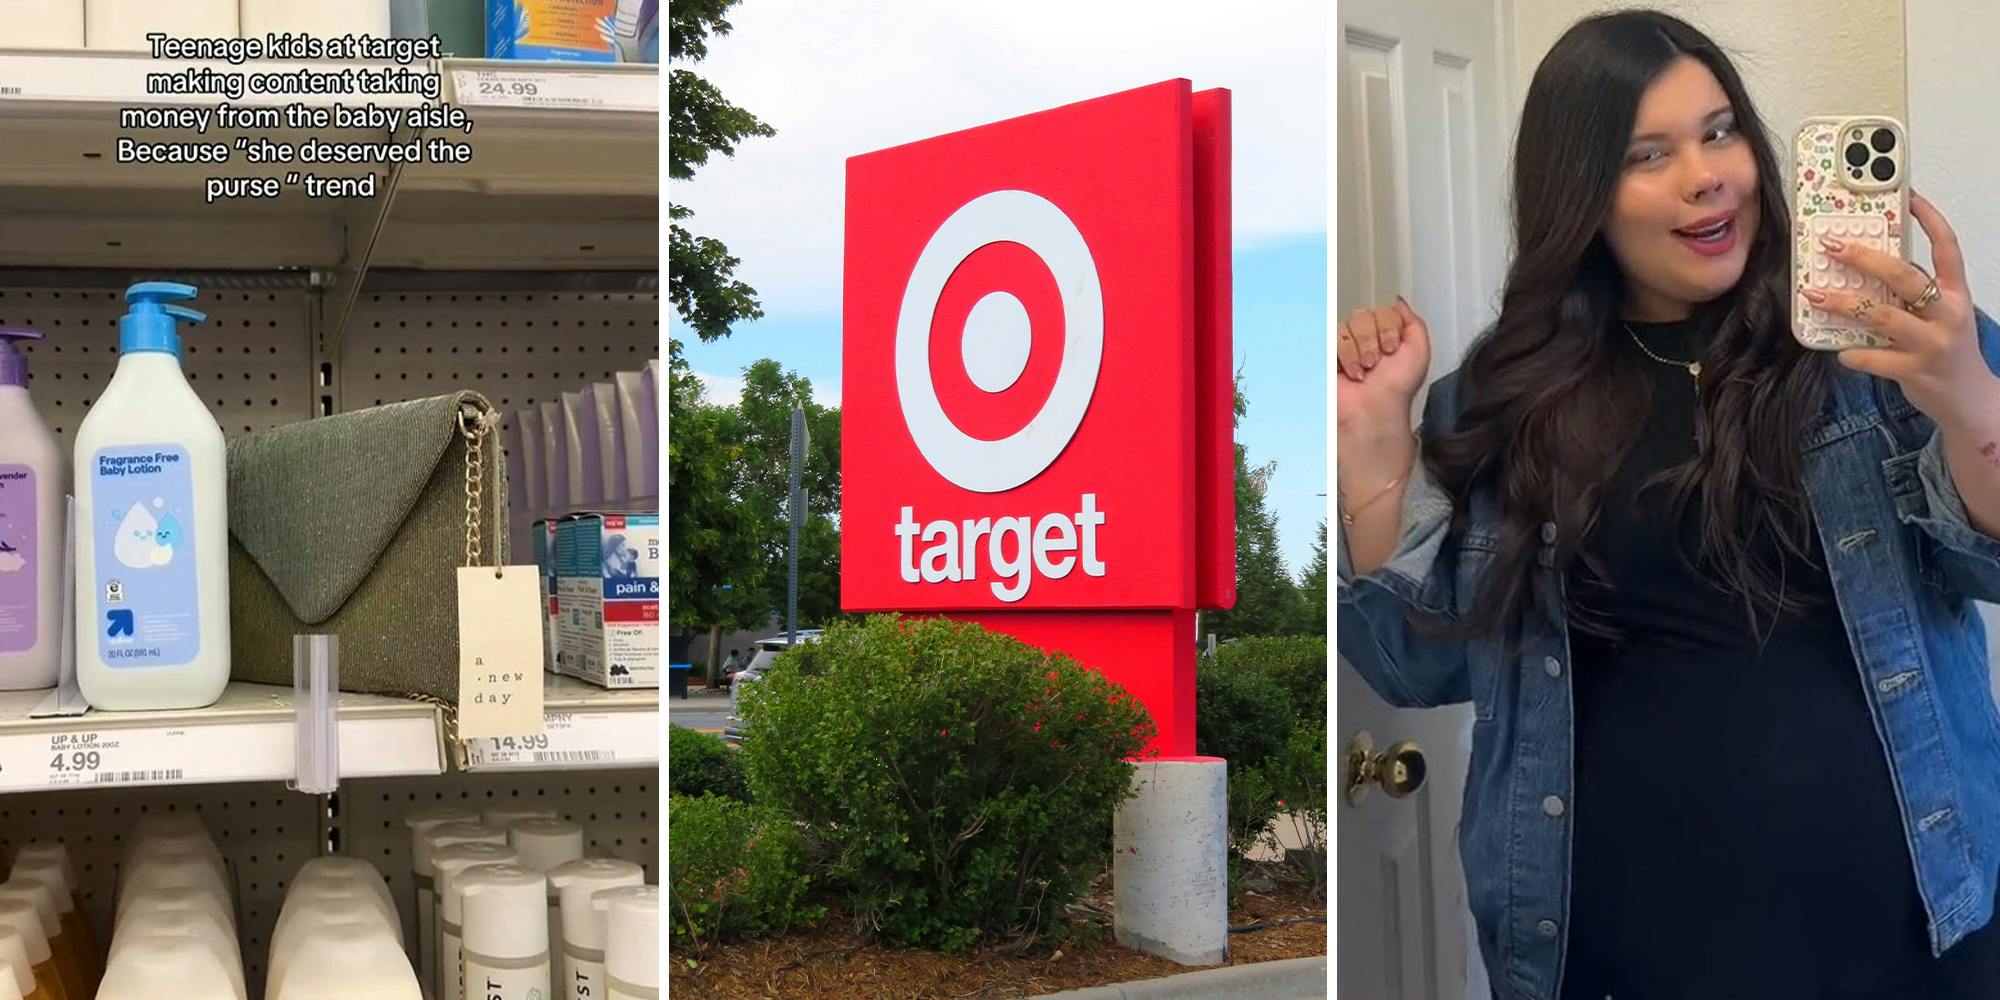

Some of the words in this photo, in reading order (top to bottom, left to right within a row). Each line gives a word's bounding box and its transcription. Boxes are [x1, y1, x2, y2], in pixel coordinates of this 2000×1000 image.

[479, 82, 538, 95] 24.99
[99, 454, 153, 467] Fragrance
[154, 452, 179, 463] Free
[99, 464, 126, 476] Baby
[127, 464, 161, 474] Lotion
[894, 493, 1105, 603] target
[616, 581, 646, 596] pain
[649, 581, 659, 593] &
[475, 657, 483, 666] a
[488, 671, 523, 683] new
[474, 693, 511, 705] day
[51, 734, 68, 745] UP
[70, 734, 78, 743] &
[81, 733, 98, 743] UP
[50, 751, 101, 771] 4.99
